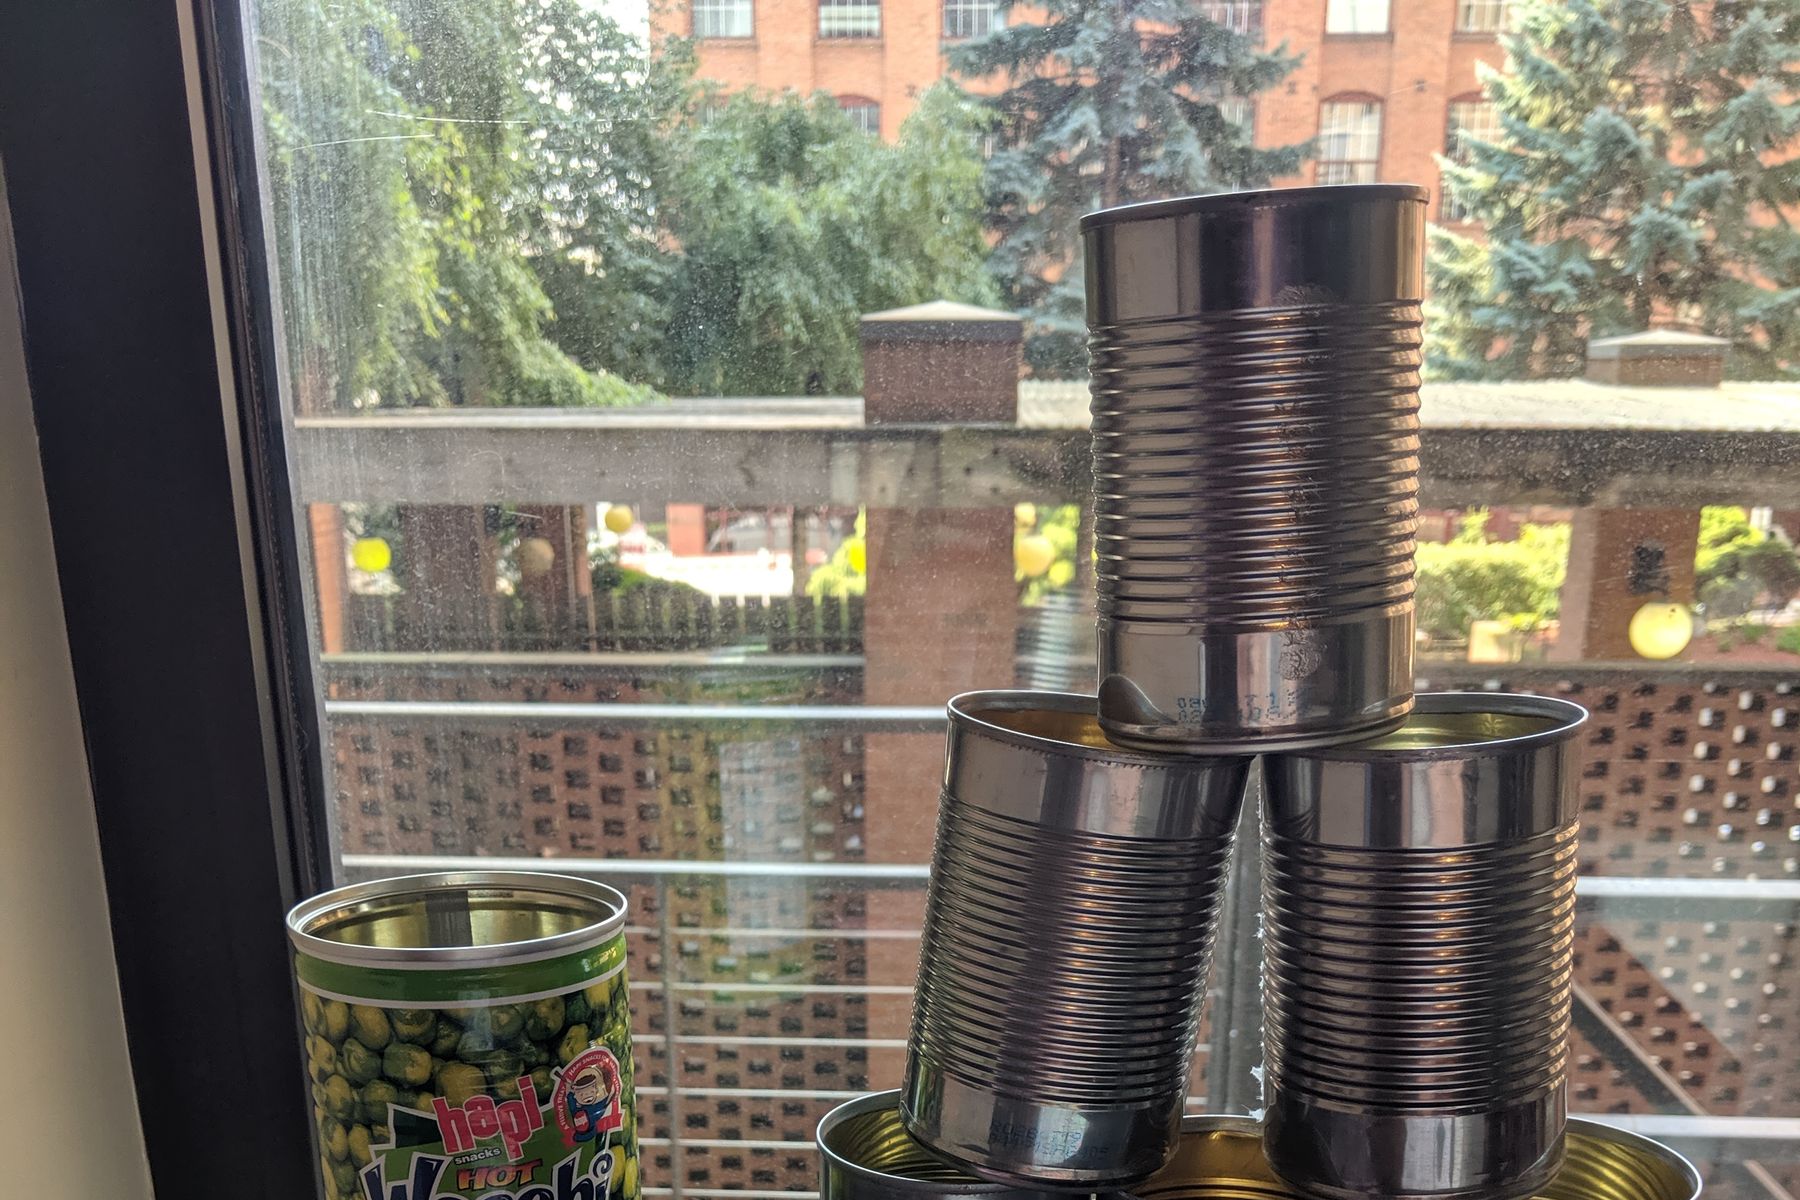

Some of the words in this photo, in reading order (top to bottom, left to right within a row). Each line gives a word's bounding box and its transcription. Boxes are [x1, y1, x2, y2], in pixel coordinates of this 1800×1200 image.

[431, 1075, 545, 1162] hapi
[455, 1148, 501, 1165] snacks
[457, 1158, 543, 1191] HOT
